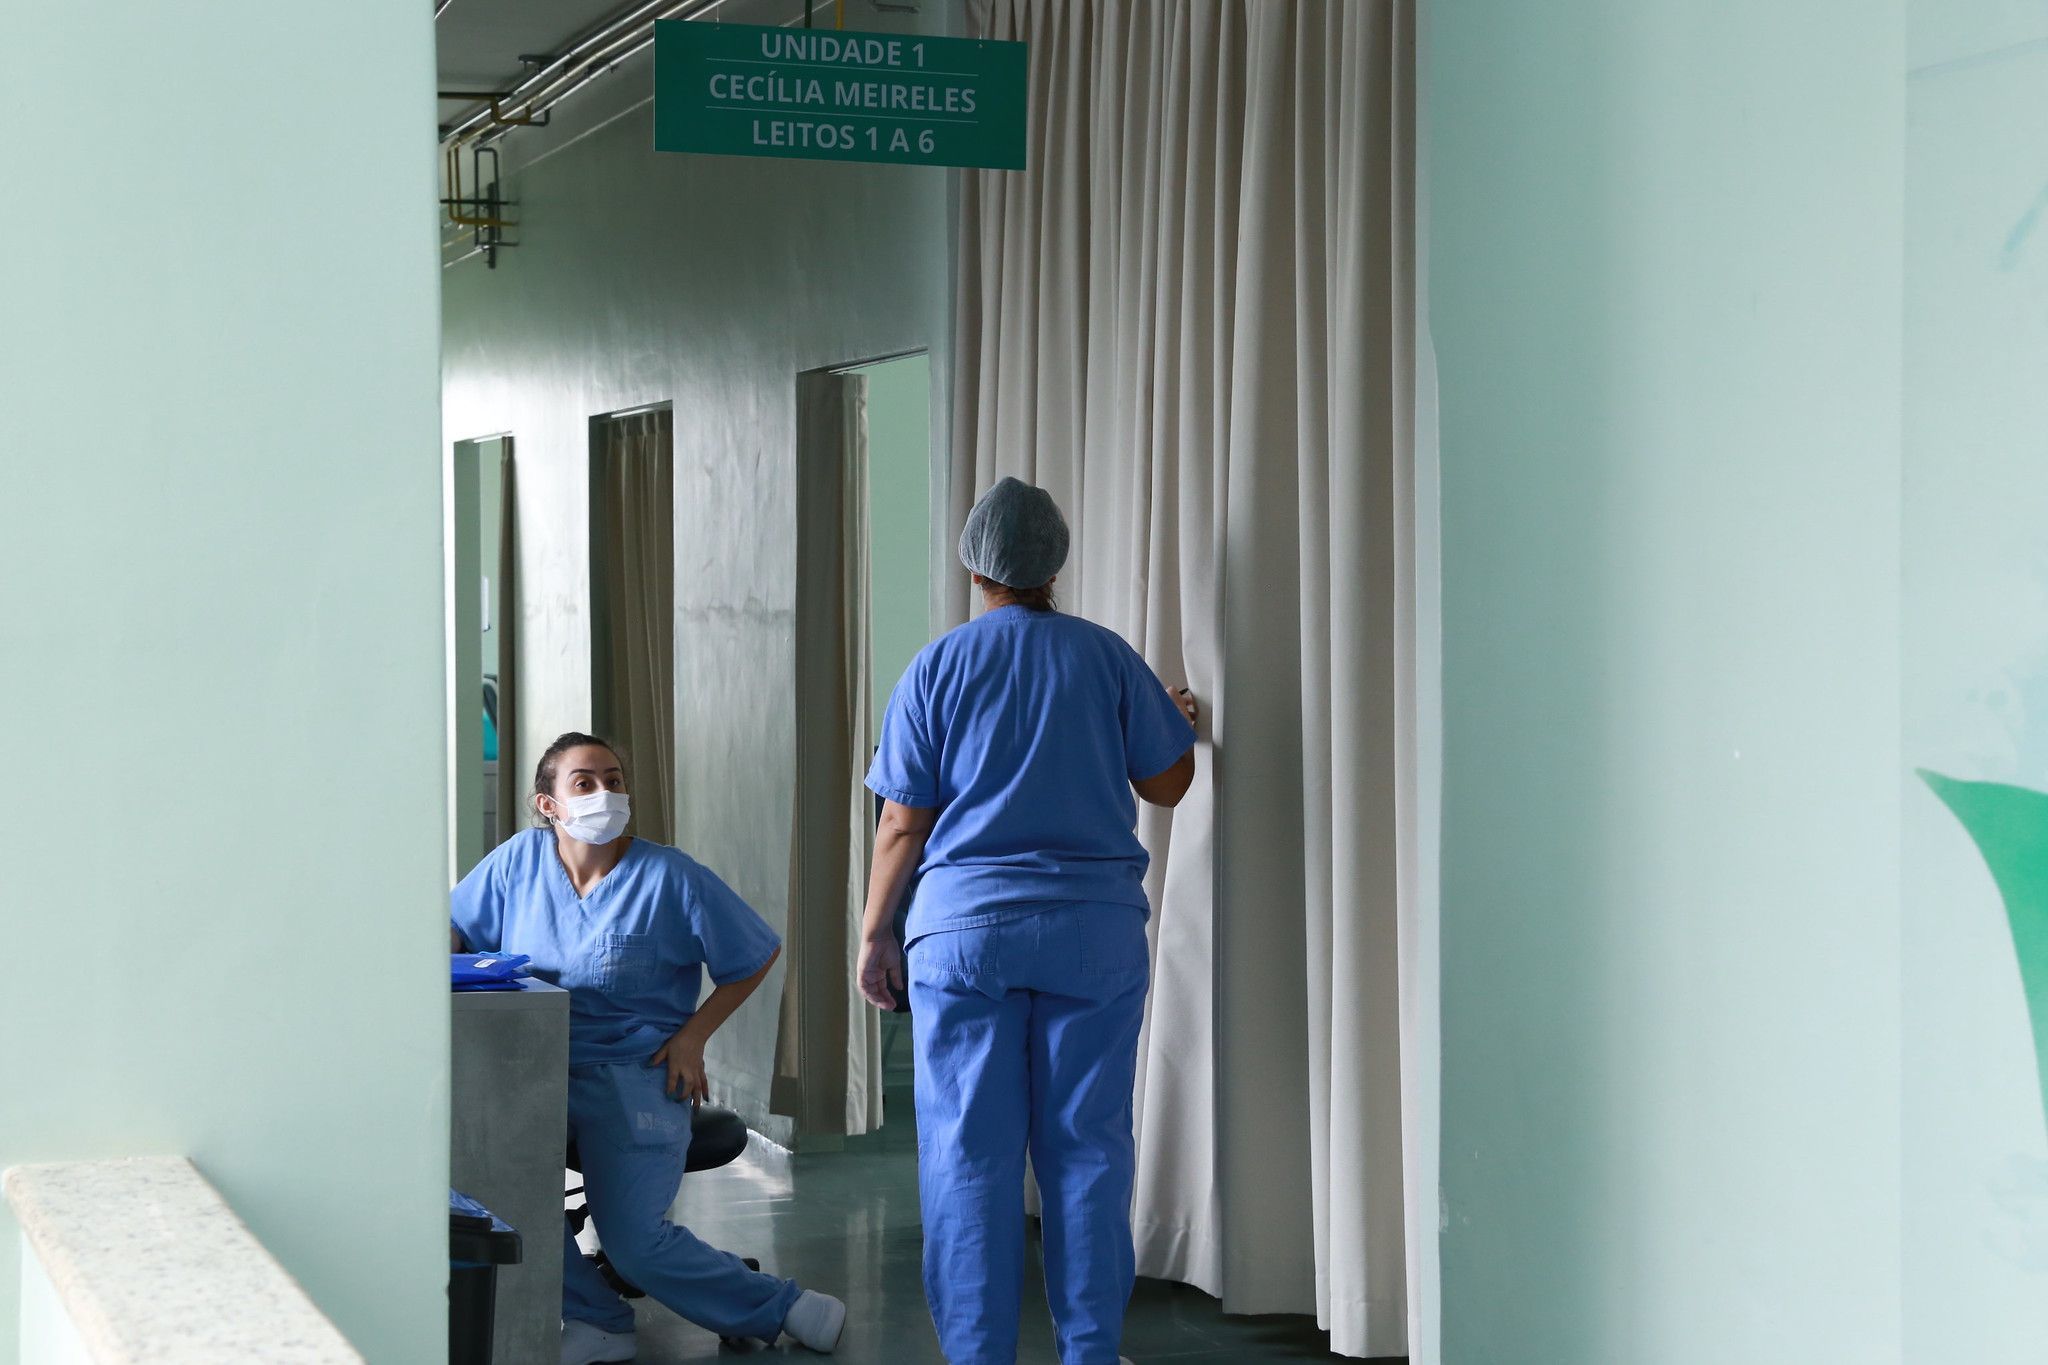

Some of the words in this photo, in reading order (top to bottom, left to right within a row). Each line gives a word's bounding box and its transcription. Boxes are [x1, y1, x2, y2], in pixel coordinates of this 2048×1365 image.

[761, 33, 901, 66] UNIDADE
[912, 43, 925, 67] 1
[709, 71, 824, 105] CECÍLIA
[834, 82, 976, 113] MEIRELES
[753, 120, 855, 149] LEITOS
[865, 127, 878, 151] 1
[889, 128, 910, 153] A
[917, 130, 935, 153] 6
